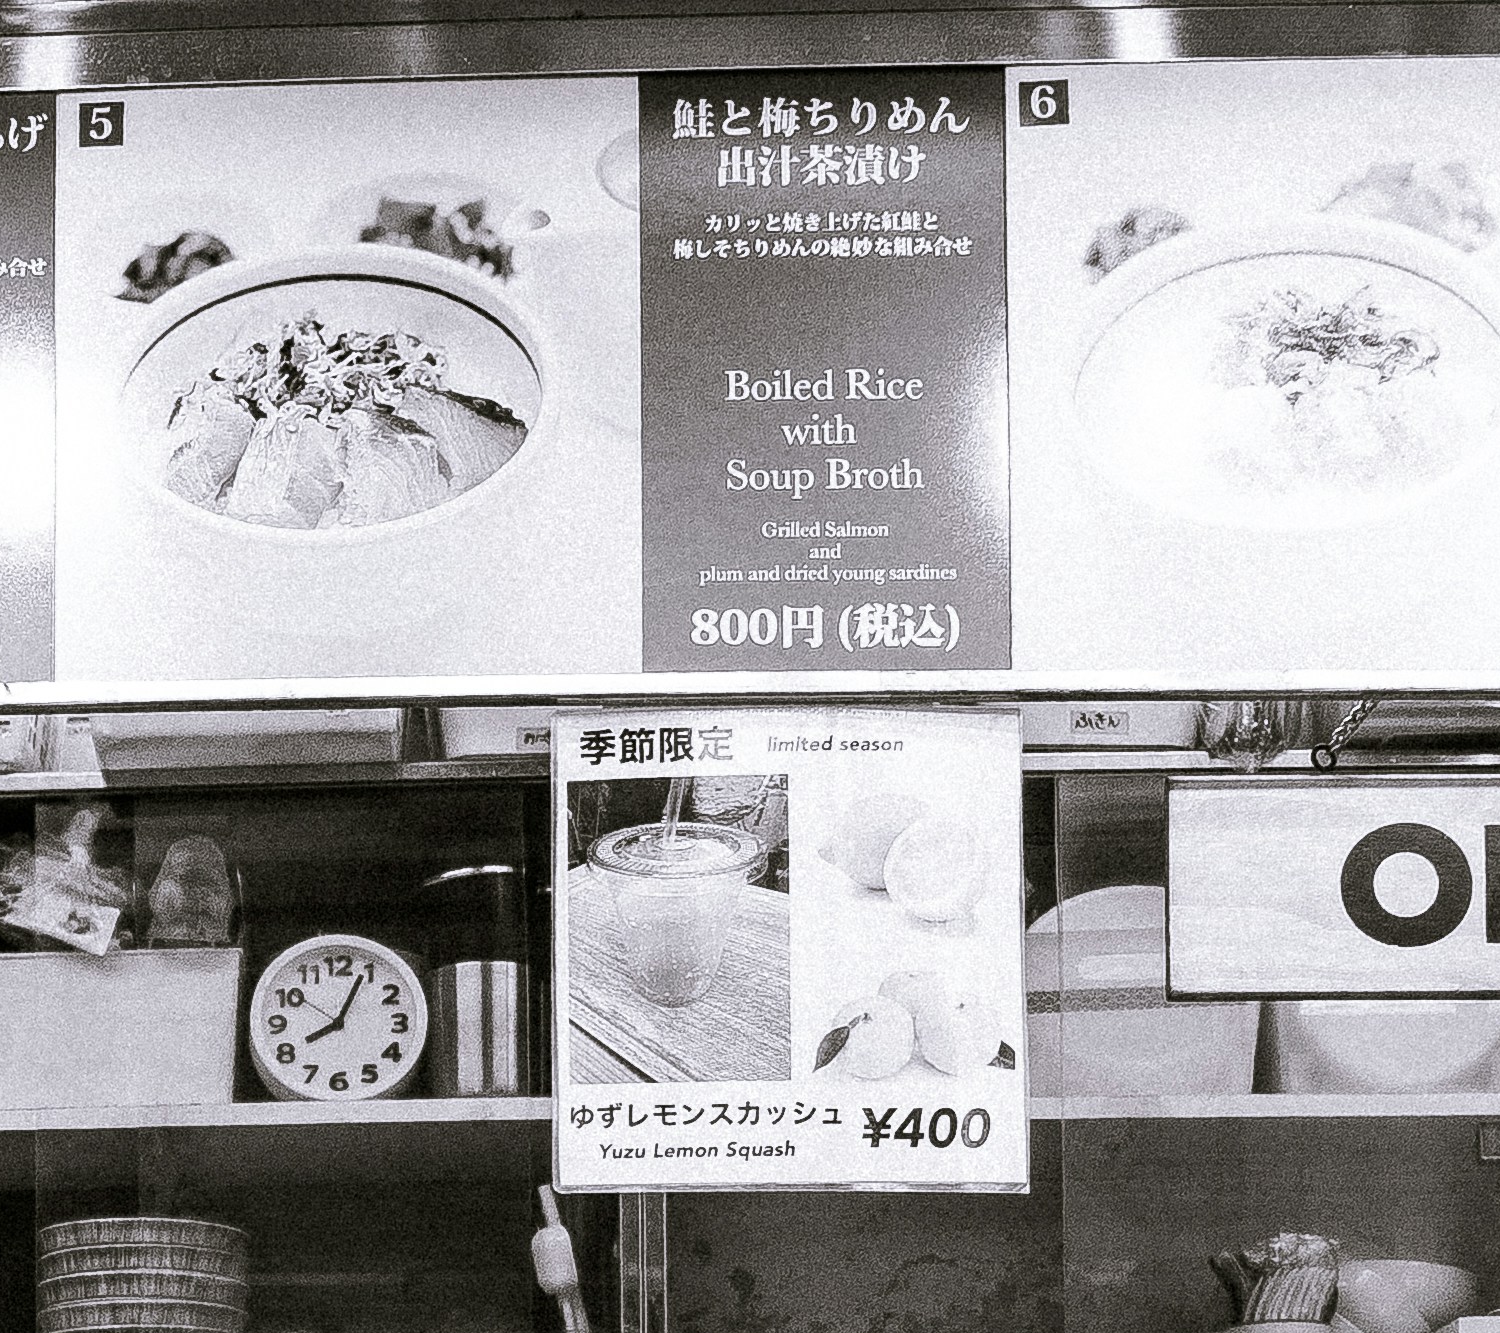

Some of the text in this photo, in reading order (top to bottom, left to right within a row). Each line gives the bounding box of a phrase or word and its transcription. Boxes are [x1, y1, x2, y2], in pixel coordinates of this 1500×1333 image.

[1029, 85, 1058, 119] 6
[89, 107, 113, 140] 5
[672, 96, 971, 140] 鮭と梅ちりめん
[716, 143, 927, 188] 出汁茶漬け
[704, 211, 939, 235] カリッと焼き上げた紅鮭と
[723, 368, 924, 402] Boiled Rice
[781, 413, 857, 446] with
[725, 457, 925, 501] Soup Broth
[761, 521, 890, 539] Grilled Salmon
[808, 543, 842, 560] and
[698, 564, 958, 587] plum and dried young sardines
[580, 725, 904, 765] 季節限定 limited season
[297, 964, 319, 984] 11
[324, 955, 353, 976] 12
[364, 962, 374, 983] 1
[276, 988, 304, 1008] 10
[382, 984, 400, 1005] 2
[268, 1015, 287, 1034] 9
[391, 1013, 408, 1033] 3
[276, 1043, 295, 1064] 8
[381, 1042, 402, 1063] 4
[303, 1065, 318, 1084] 7
[329, 1072, 349, 1091] 6
[361, 1064, 378, 1083] 5
[570, 1100, 843, 1129] ゆずレモンスカッシュ
[600, 1142, 796, 1161] Yuzu Lemon Squash
